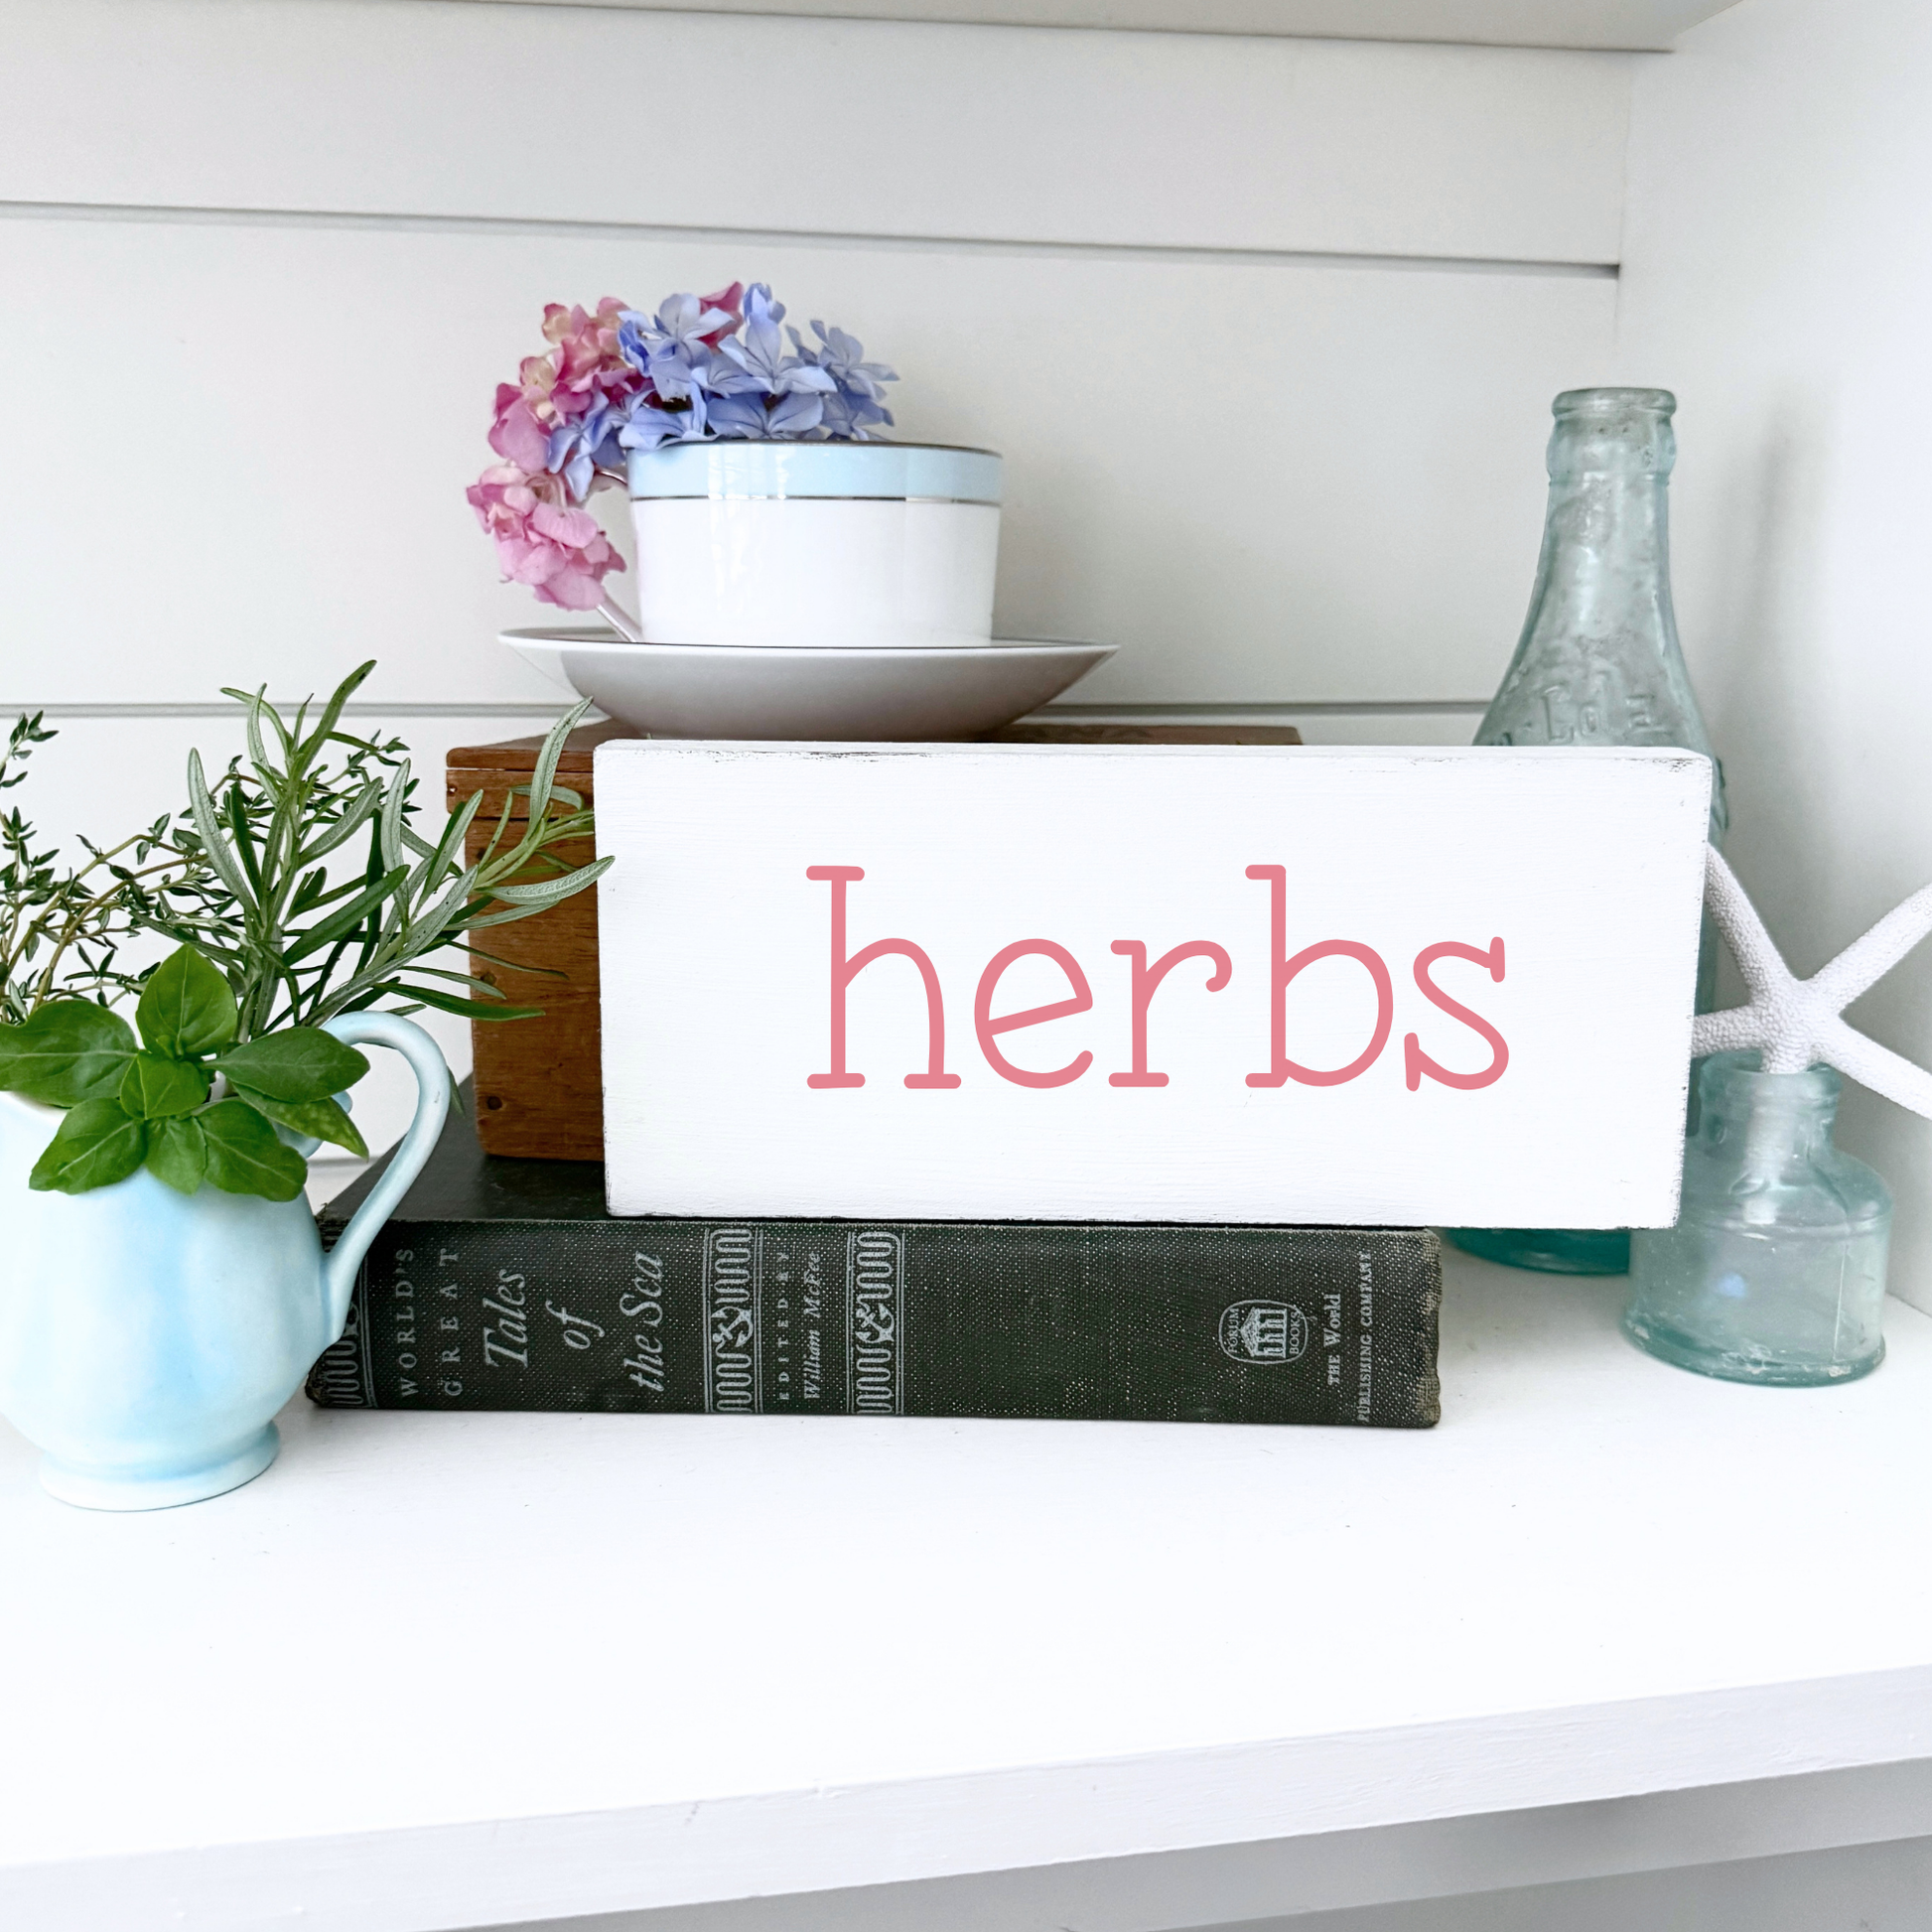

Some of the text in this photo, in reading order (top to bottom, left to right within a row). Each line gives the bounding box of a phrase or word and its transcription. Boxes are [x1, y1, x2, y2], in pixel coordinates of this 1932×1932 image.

[806, 865, 1509, 1091] herbs
[393, 1249, 419, 1398] WORLD'S
[439, 1248, 463, 1397] GREAT
[482, 1267, 530, 1369] Tales
[545, 1300, 606, 1350] of
[618, 1250, 665, 1393] the Sea
[775, 1252, 790, 1400] EDITED BY
[802, 1251, 821, 1399] William McFee
[1227, 1308, 1241, 1354] FORUM
[1290, 1311, 1305, 1354] BOOKS
[1323, 1293, 1341, 1386] THE World
[1357, 1250, 1372, 1422] PUBLISHING COMPANY
